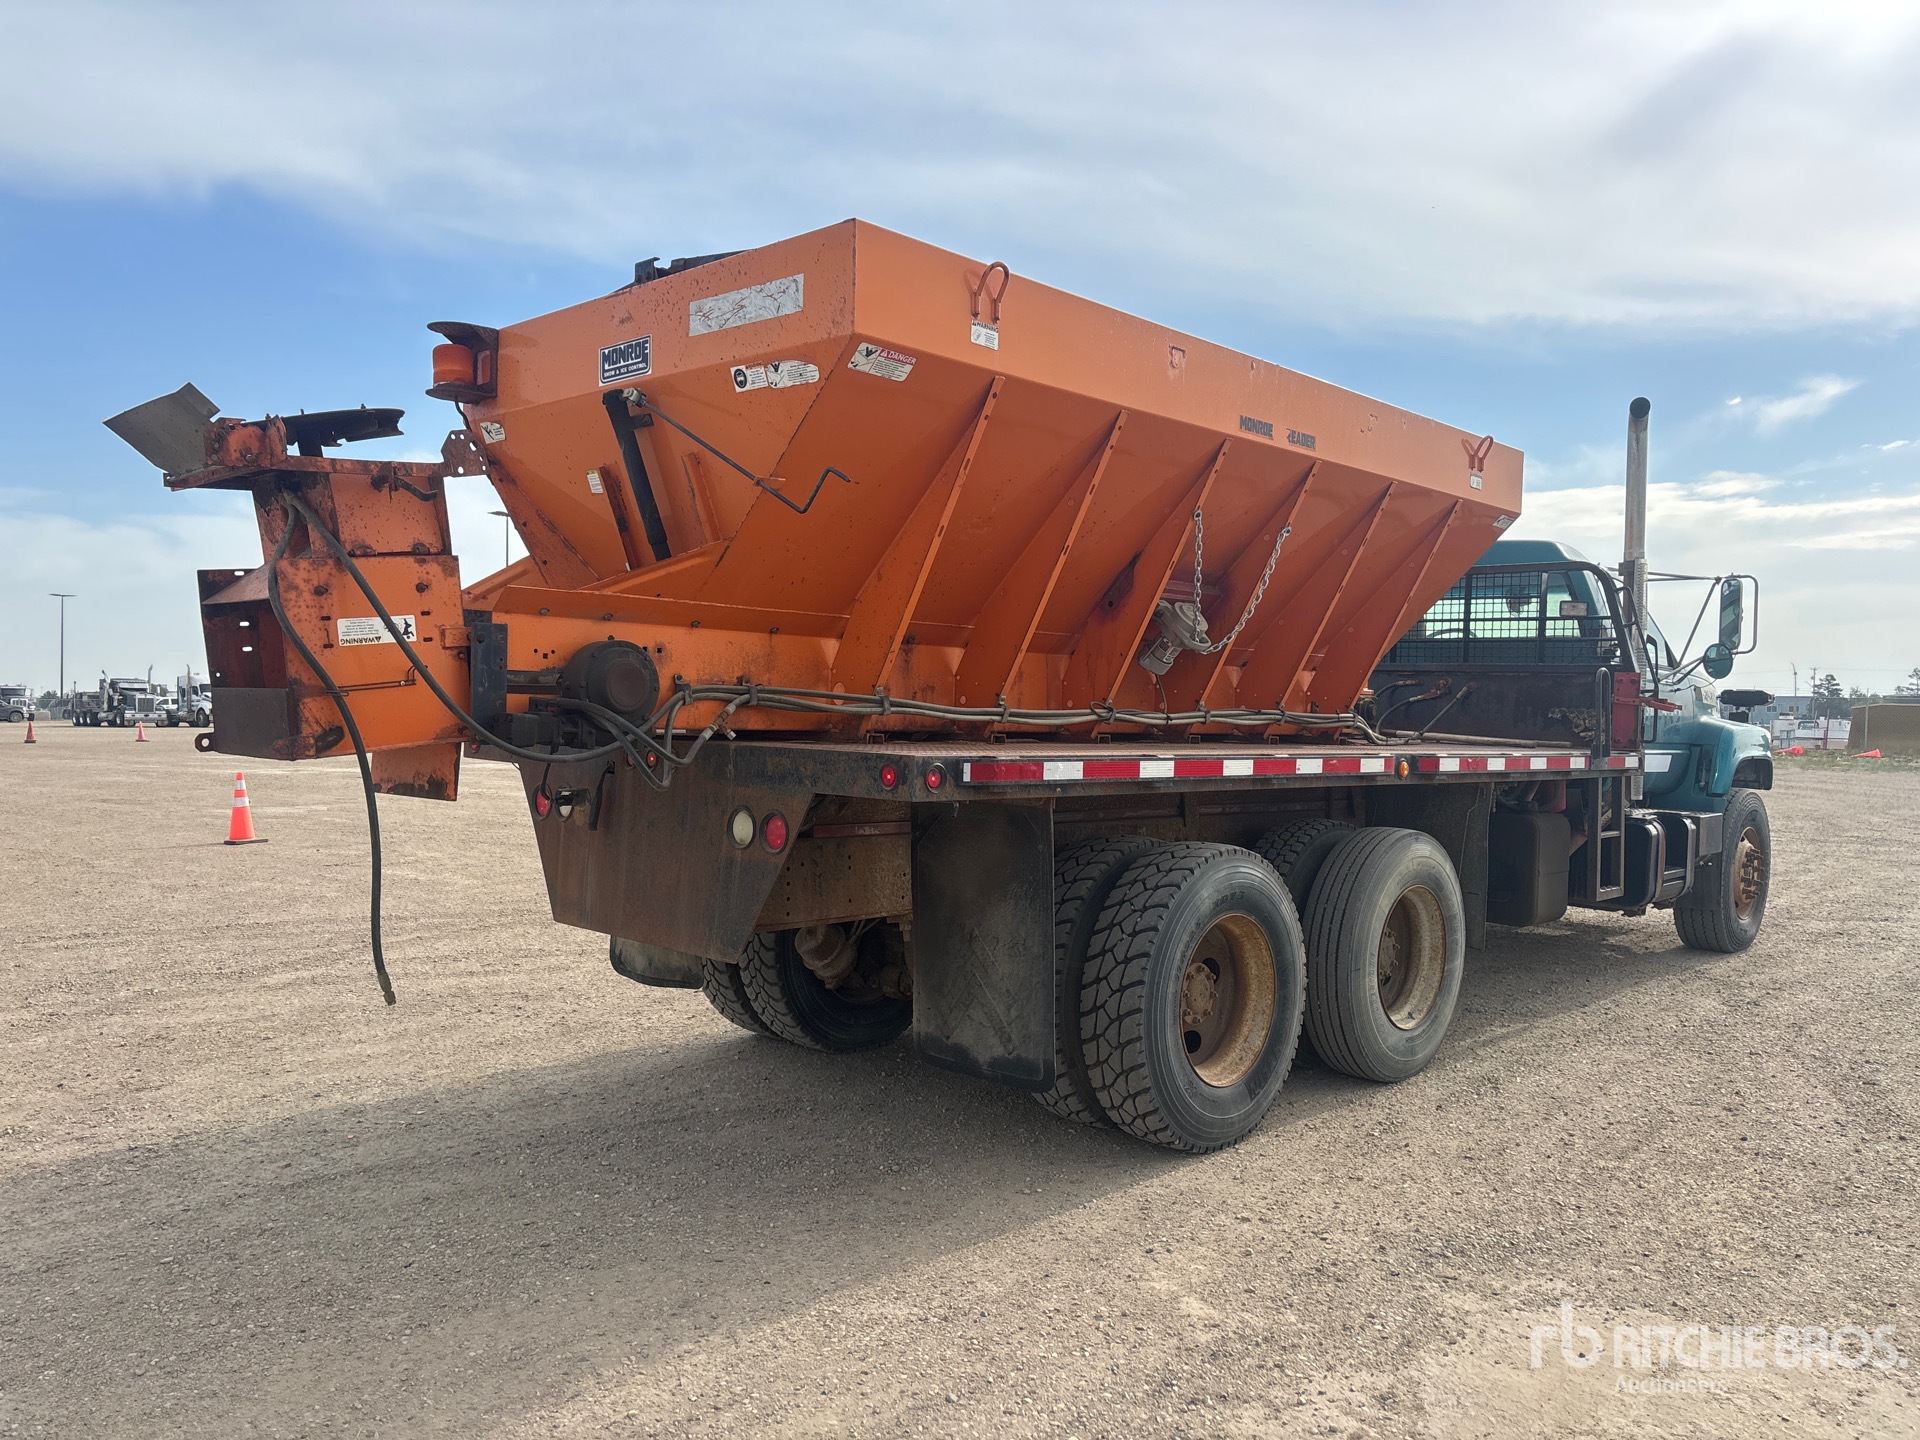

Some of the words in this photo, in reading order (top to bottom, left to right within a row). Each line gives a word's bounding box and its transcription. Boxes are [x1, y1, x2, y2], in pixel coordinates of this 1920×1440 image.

[602, 339, 649, 368] MONROE
[888, 351, 917, 365] DANGER
[628, 362, 647, 371] CONTROL
[1240, 415, 1273, 437] MONROE
[340, 636, 376, 645] WARNING
